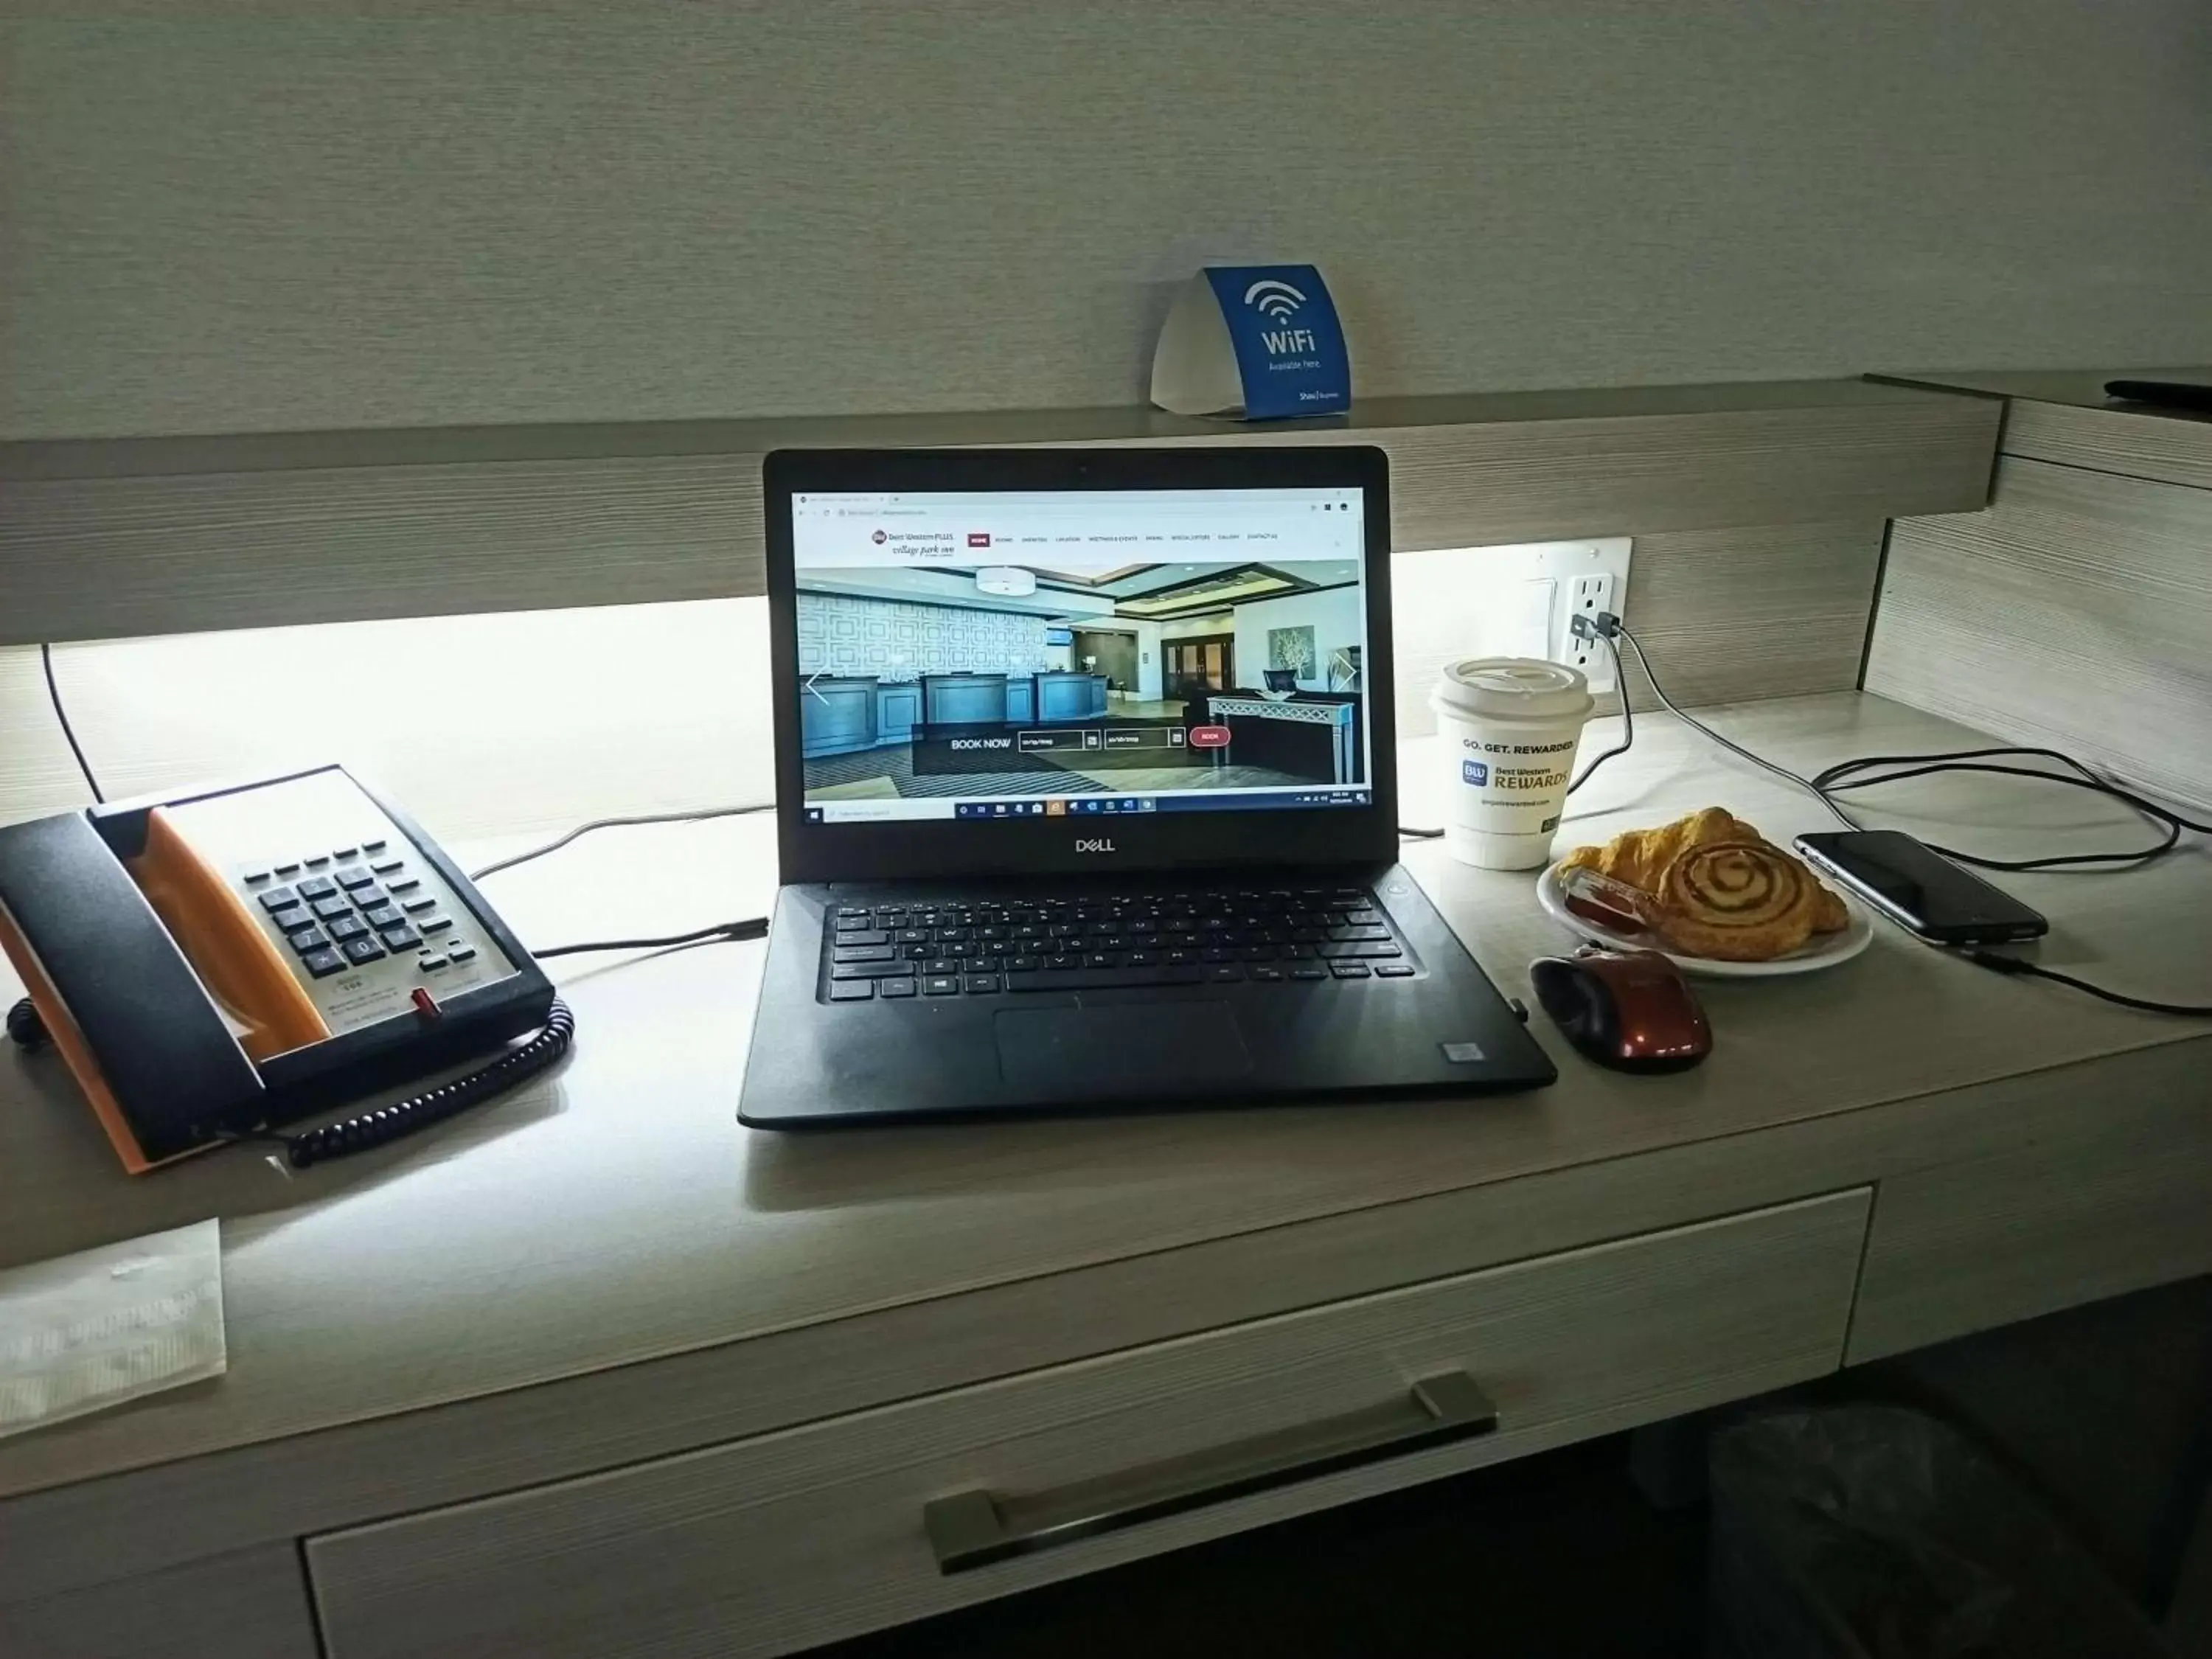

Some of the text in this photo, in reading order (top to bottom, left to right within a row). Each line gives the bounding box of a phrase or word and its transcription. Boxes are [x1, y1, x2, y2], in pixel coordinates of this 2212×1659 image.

[1262, 330, 1316, 355] WiFi
[892, 545, 919, 557] village
[919, 545, 939, 556] park
[951, 739, 982, 750] BOOK
[983, 738, 1011, 748] NOW
[1462, 739, 1482, 751] GO.
[1484, 743, 1511, 754] GET.
[1495, 766, 1551, 776] Best Western
[1495, 771, 1568, 790] REWARDS
[1075, 838, 1116, 852] DELL
